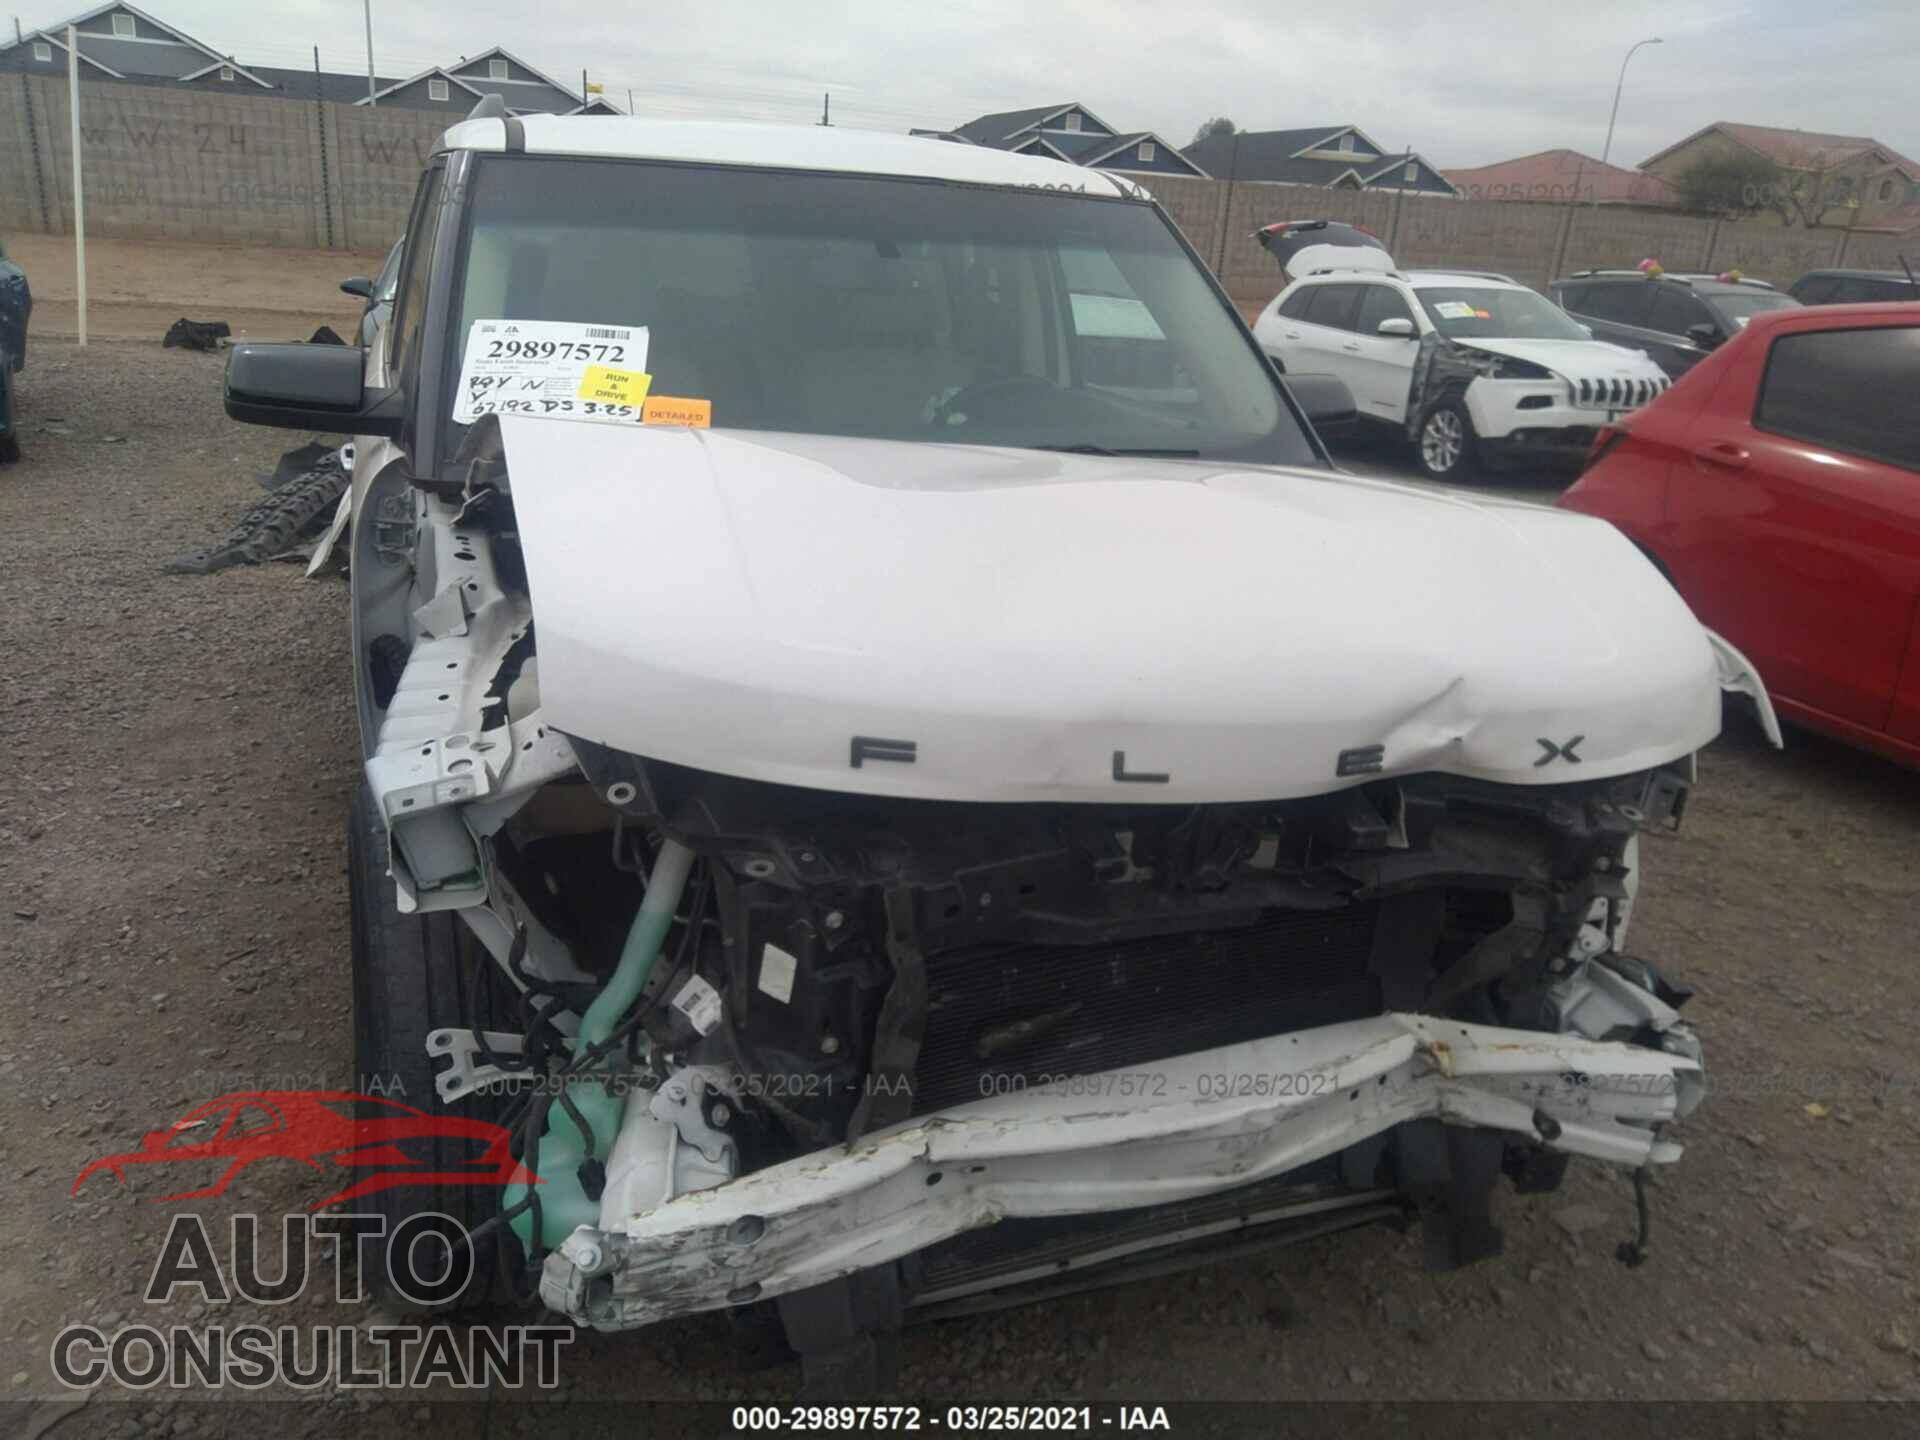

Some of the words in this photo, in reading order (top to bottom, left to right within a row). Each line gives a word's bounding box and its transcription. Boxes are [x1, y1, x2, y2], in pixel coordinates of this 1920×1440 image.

[488, 340, 625, 362] 29897572
[606, 373, 629, 383] RUN
[595, 390, 628, 400] DRIVE
[650, 410, 704, 422] DETAILED
[850, 735, 1585, 784] FLEX
